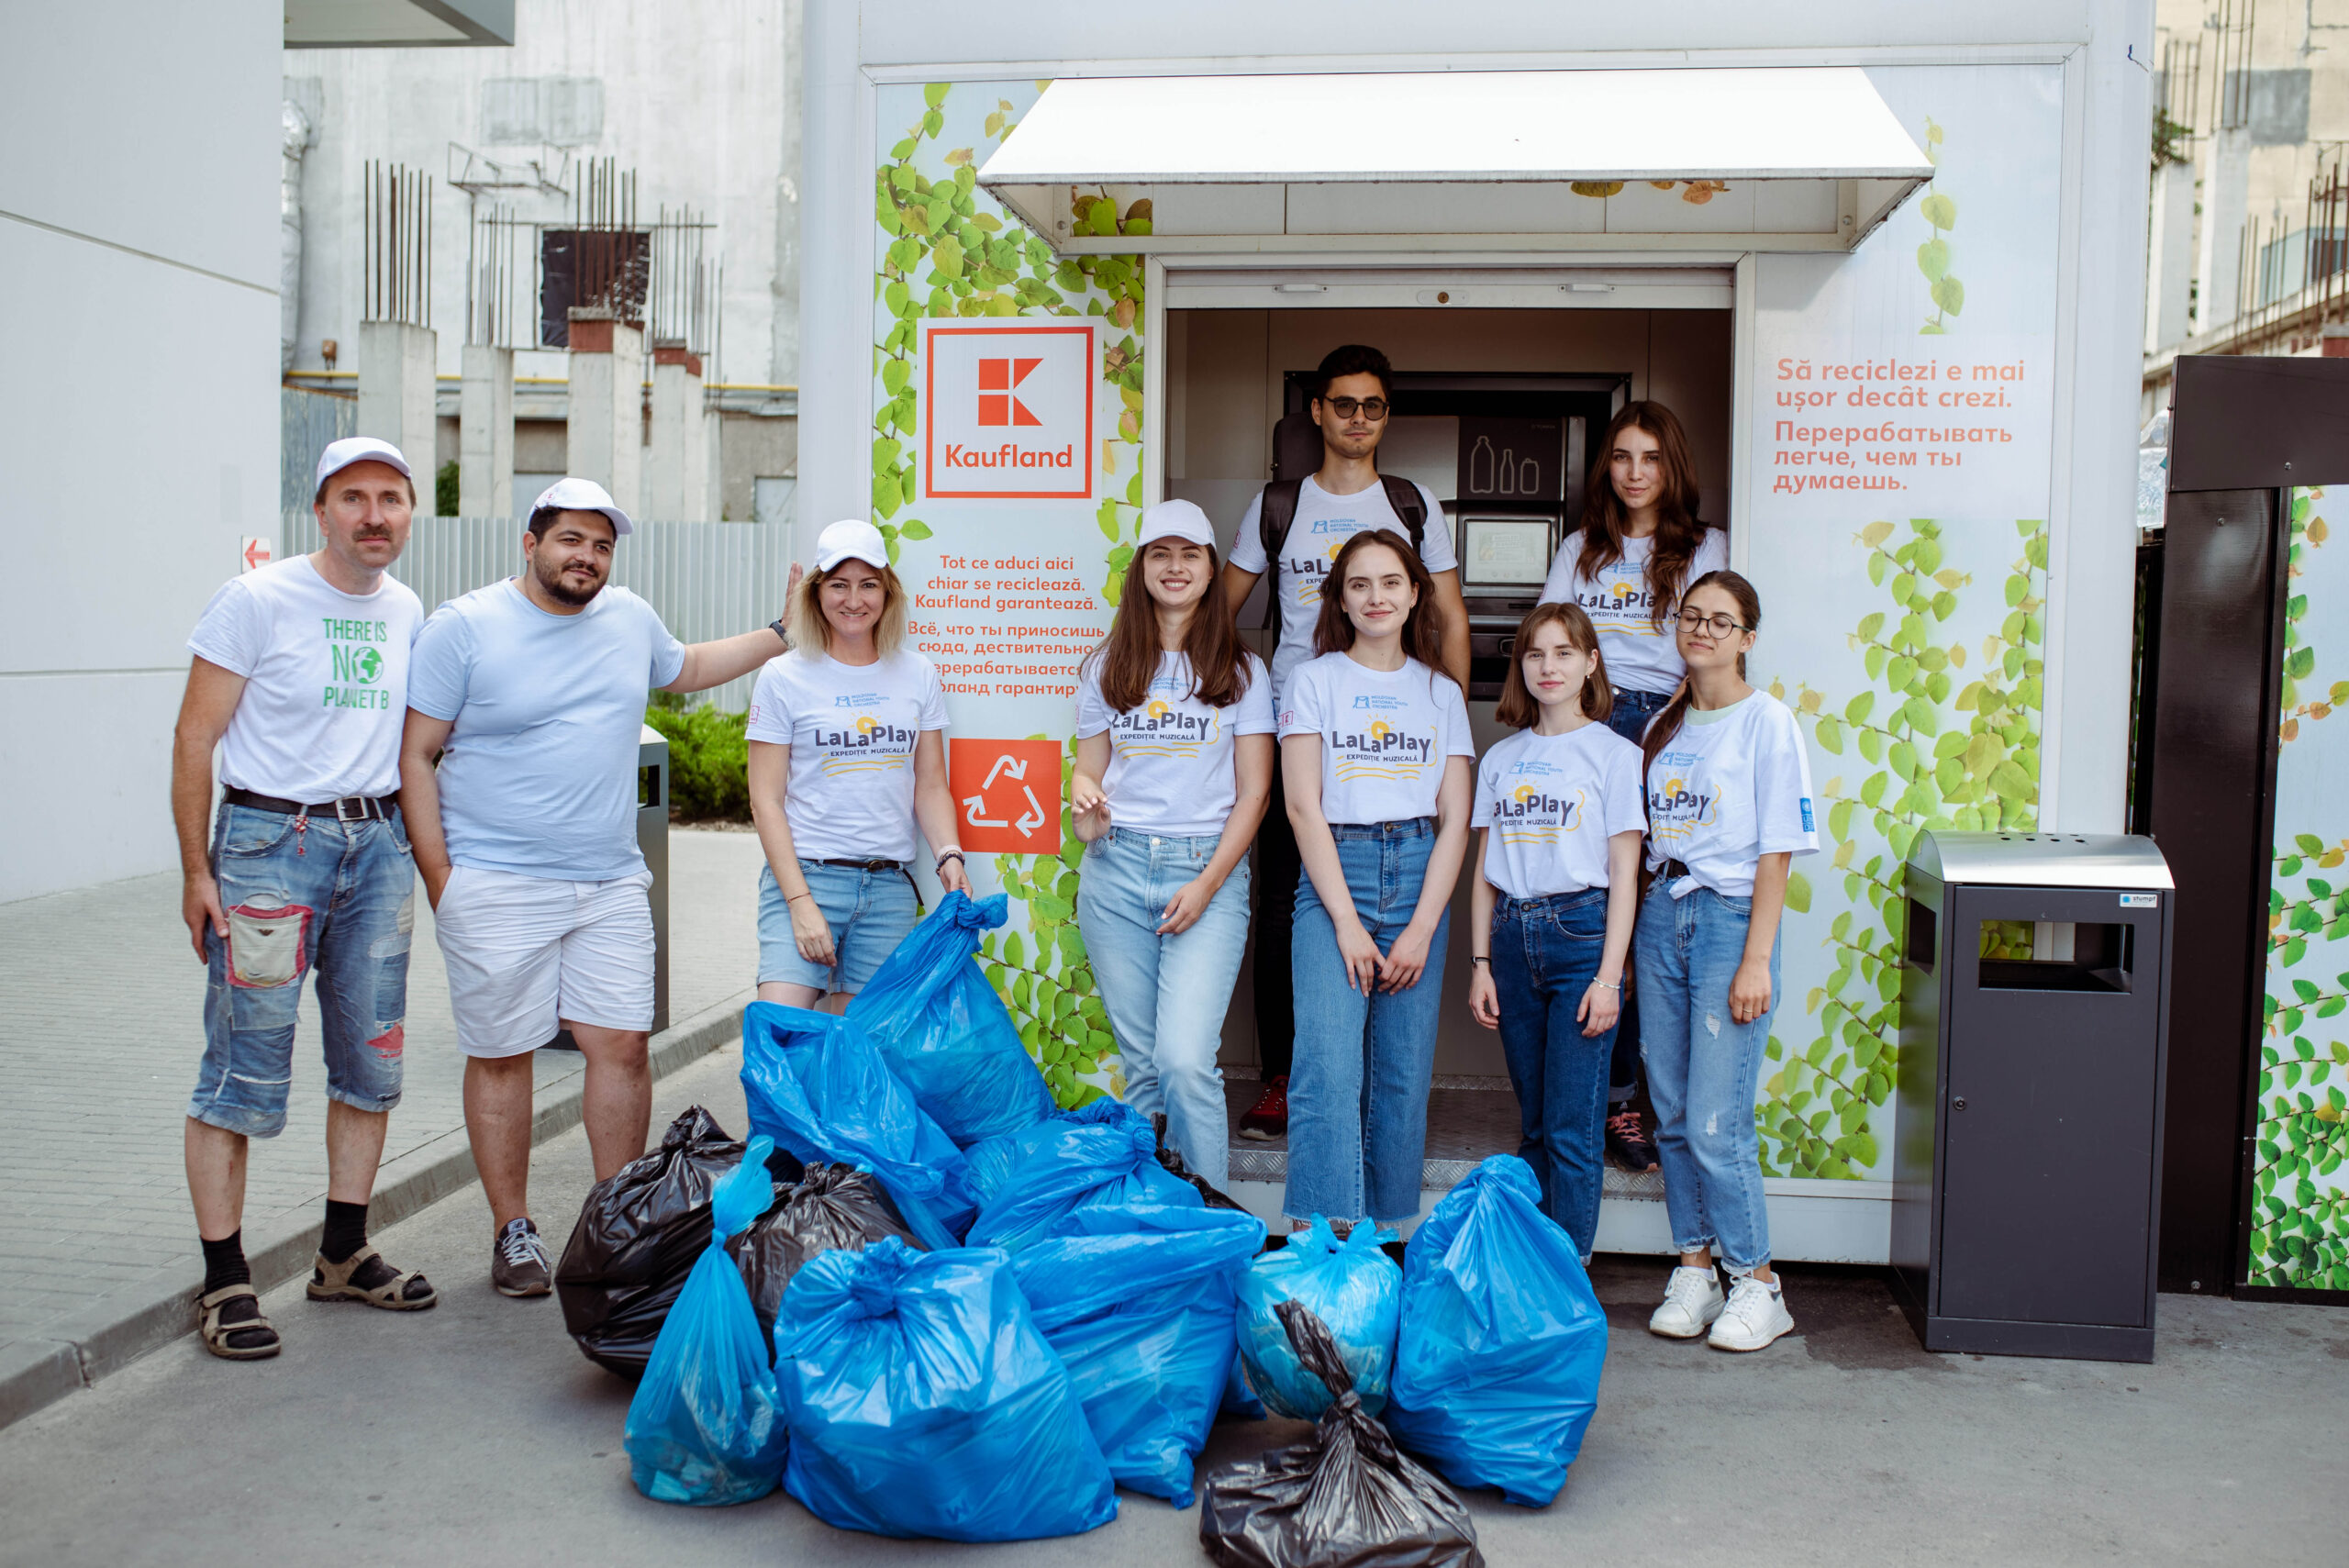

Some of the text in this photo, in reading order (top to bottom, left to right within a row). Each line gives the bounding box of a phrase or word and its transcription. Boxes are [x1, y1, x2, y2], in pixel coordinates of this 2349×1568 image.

[1777, 358, 2024, 381] Să reciclezi e mai
[1776, 385, 2011, 413] ușor decât crezi.
[1776, 421, 2012, 447] Перерабатывать
[946, 444, 1072, 468] Kaufland
[1775, 451, 1961, 469] легче, чем ты
[1773, 475, 1908, 495] думаешь.
[940, 555, 1074, 571] Tot ce aduci aici
[927, 576, 1085, 592] chiar se reciclează.
[915, 595, 1098, 613] Kaufland garantează.
[322, 618, 387, 642] THERE IS
[907, 621, 1105, 639] Всё, что ты приносишь
[918, 642, 1093, 655] сюда, дествительно
[934, 661, 1080, 677] ерерабатываетс
[323, 686, 389, 710] PLANET B
[940, 680, 1079, 698] ланд гарантир
[1111, 712, 1210, 740] LaLaPlay
[815, 725, 917, 753] LaLaPlay
[1332, 730, 1431, 762] LaLaPlay
[1346, 753, 1380, 762] EXPEDIȚIE
[1493, 795, 1575, 826] aLaPlay
